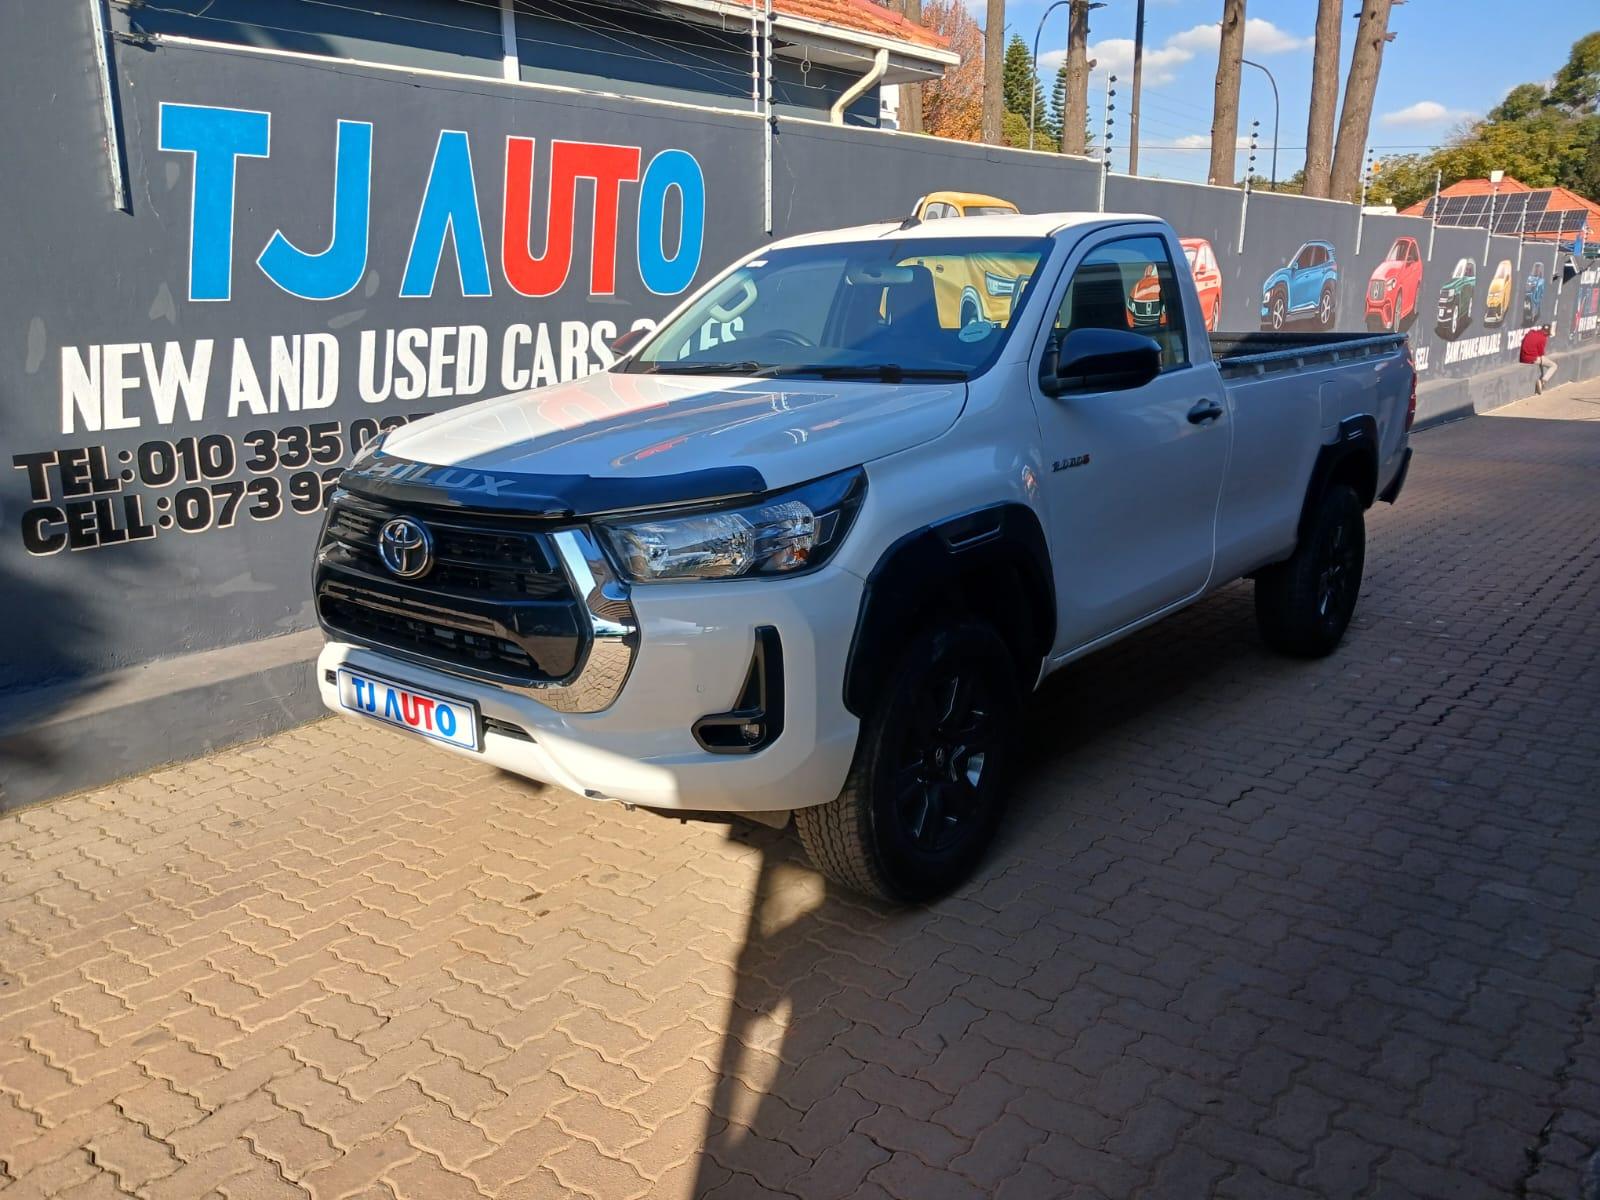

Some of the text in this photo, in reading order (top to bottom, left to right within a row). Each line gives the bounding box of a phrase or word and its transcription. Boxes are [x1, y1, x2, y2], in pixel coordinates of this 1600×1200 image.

[158, 101, 706, 302] TJ AUTO
[61, 338, 214, 435] NEW
[227, 330, 340, 418] AND
[358, 324, 491, 404] USED
[500, 319, 617, 392] CARS
[243, 421, 344, 475] 335
[357, 461, 518, 497] HILUX
[352, 676, 457, 737] TJ AUTO
